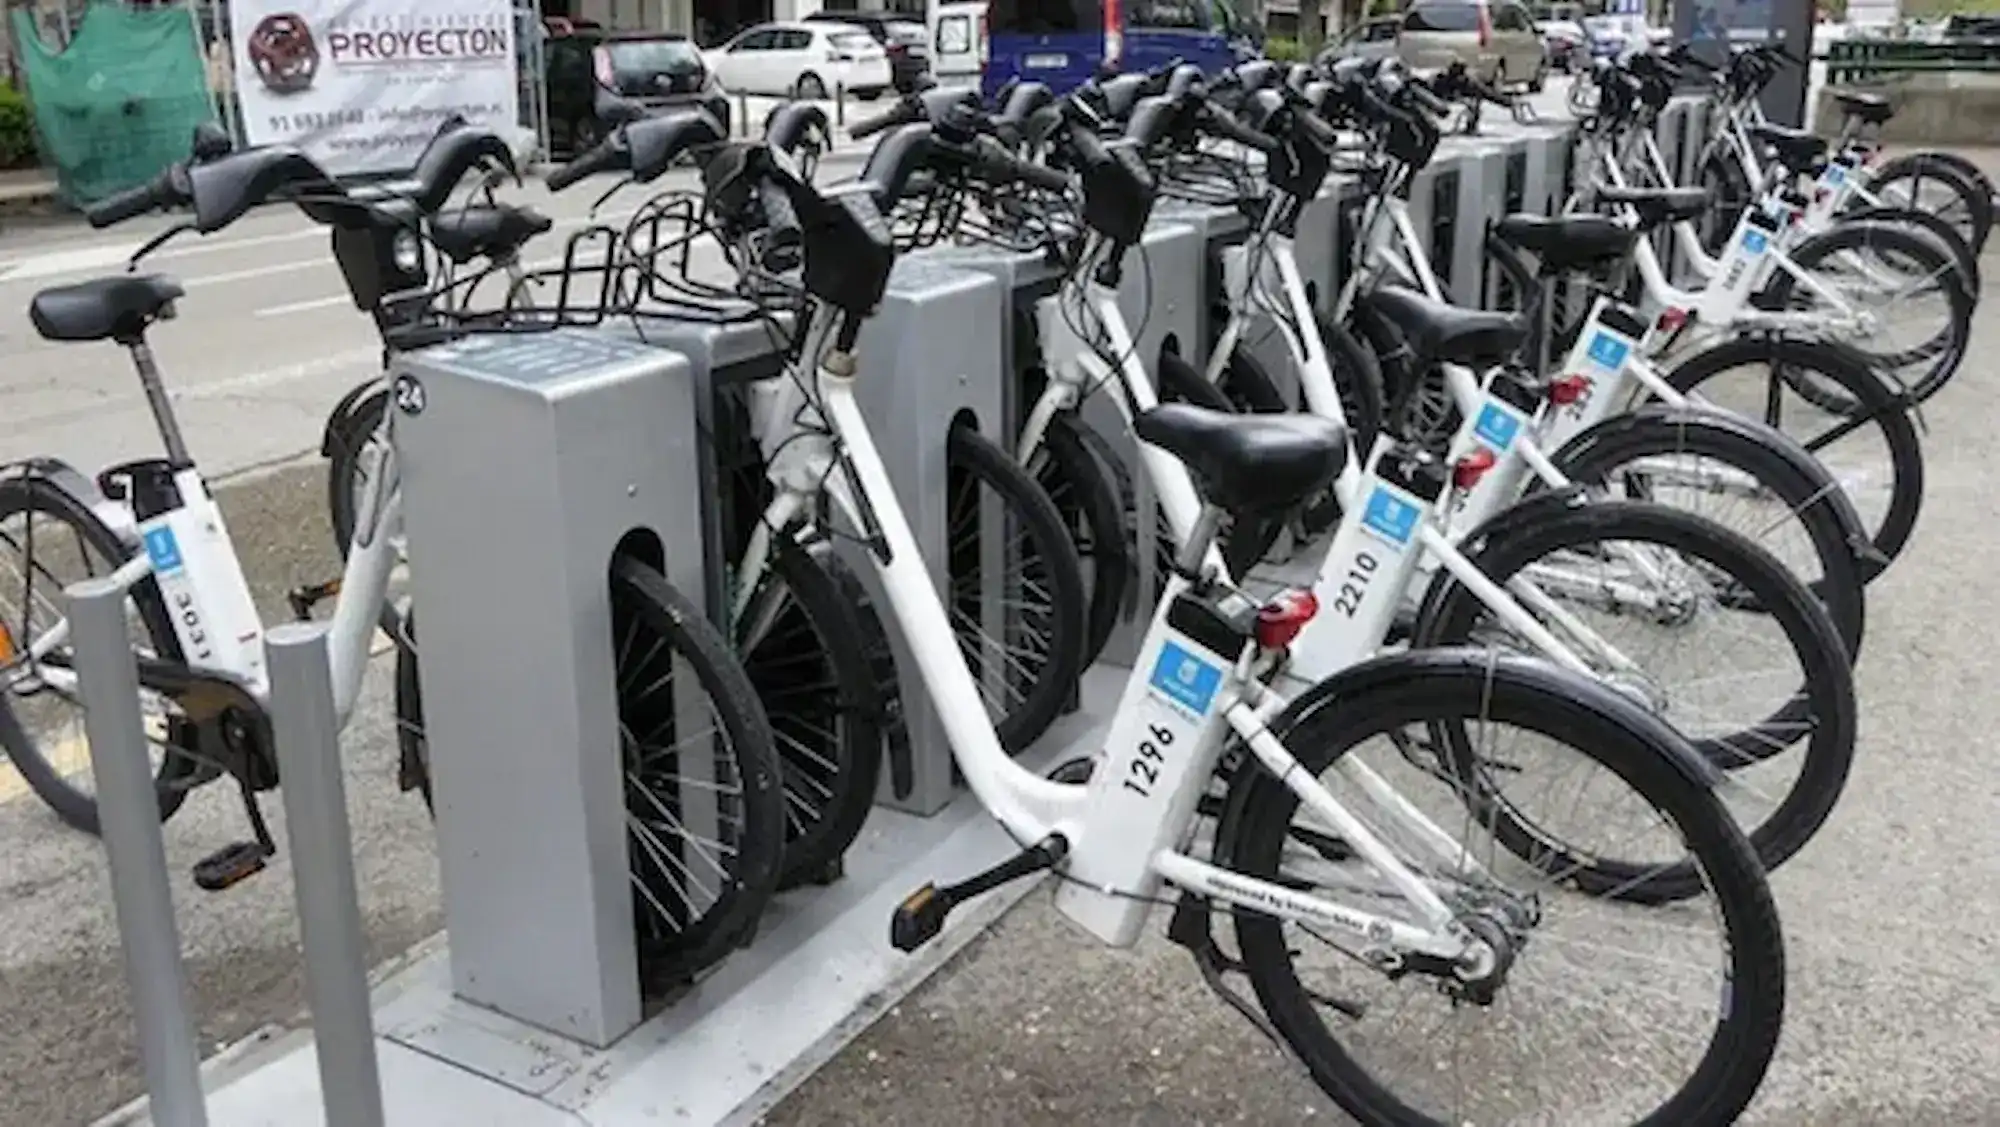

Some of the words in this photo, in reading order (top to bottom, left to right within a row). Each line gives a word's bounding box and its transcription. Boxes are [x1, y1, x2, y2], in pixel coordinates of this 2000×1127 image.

[328, 28, 508, 60] PROYECTON
[1334, 552, 1378, 619] 2210
[175, 592, 212, 660] 3031
[1123, 723, 1174, 797] 1296
